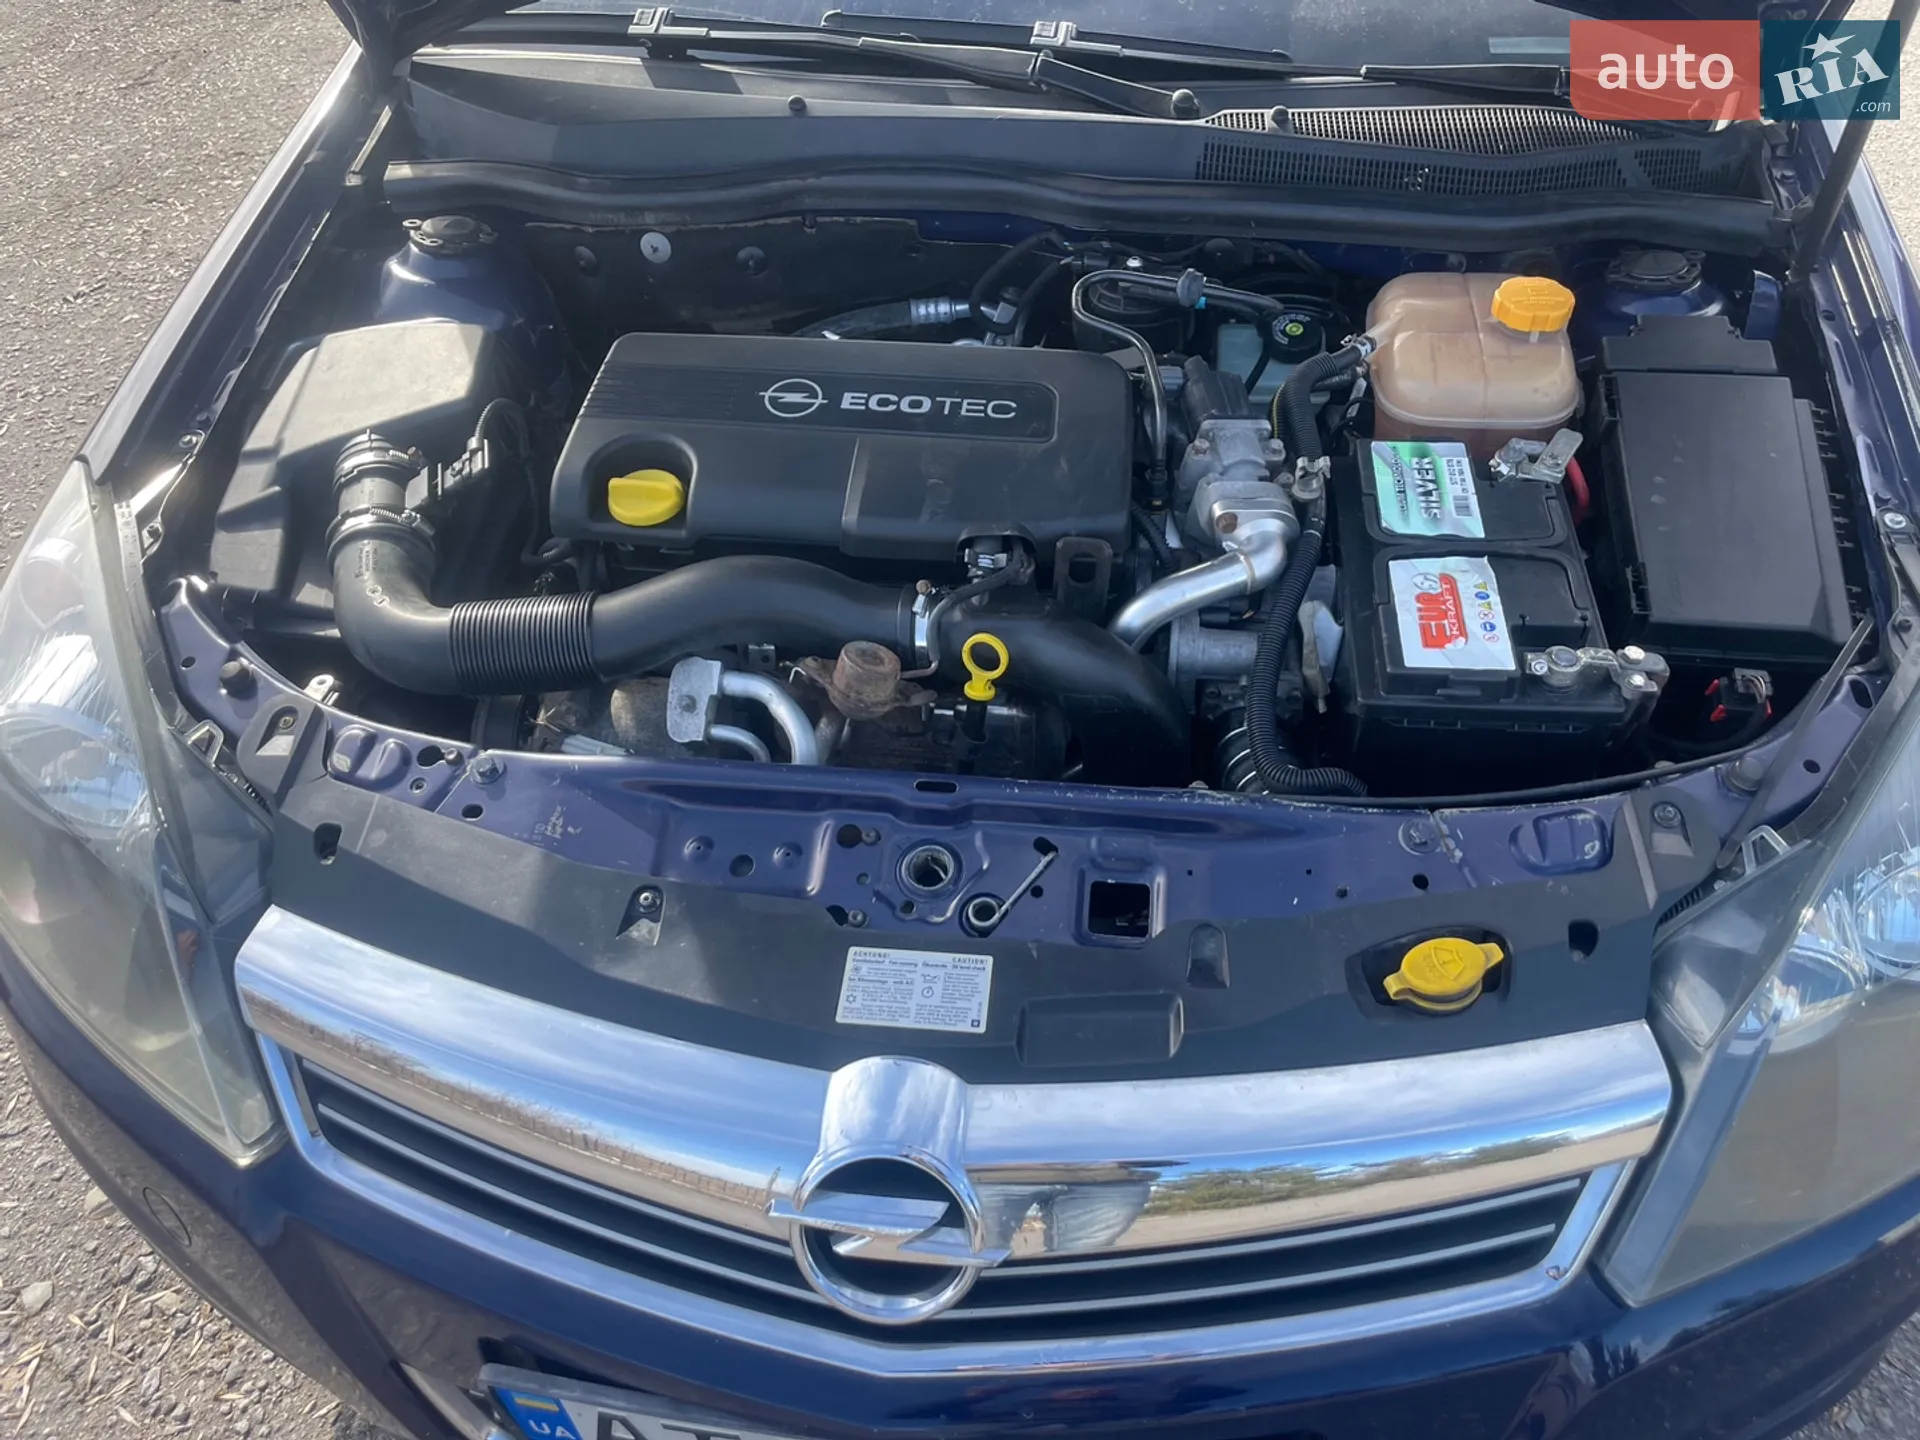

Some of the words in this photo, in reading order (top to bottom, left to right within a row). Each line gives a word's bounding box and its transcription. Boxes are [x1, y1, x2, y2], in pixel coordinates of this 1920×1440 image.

[840, 391, 1017, 418] ECOTEC
[1411, 457, 1441, 519] SILVER
[1441, 583, 1460, 635] KRAFT
[528, 1419, 577, 1440] UA
